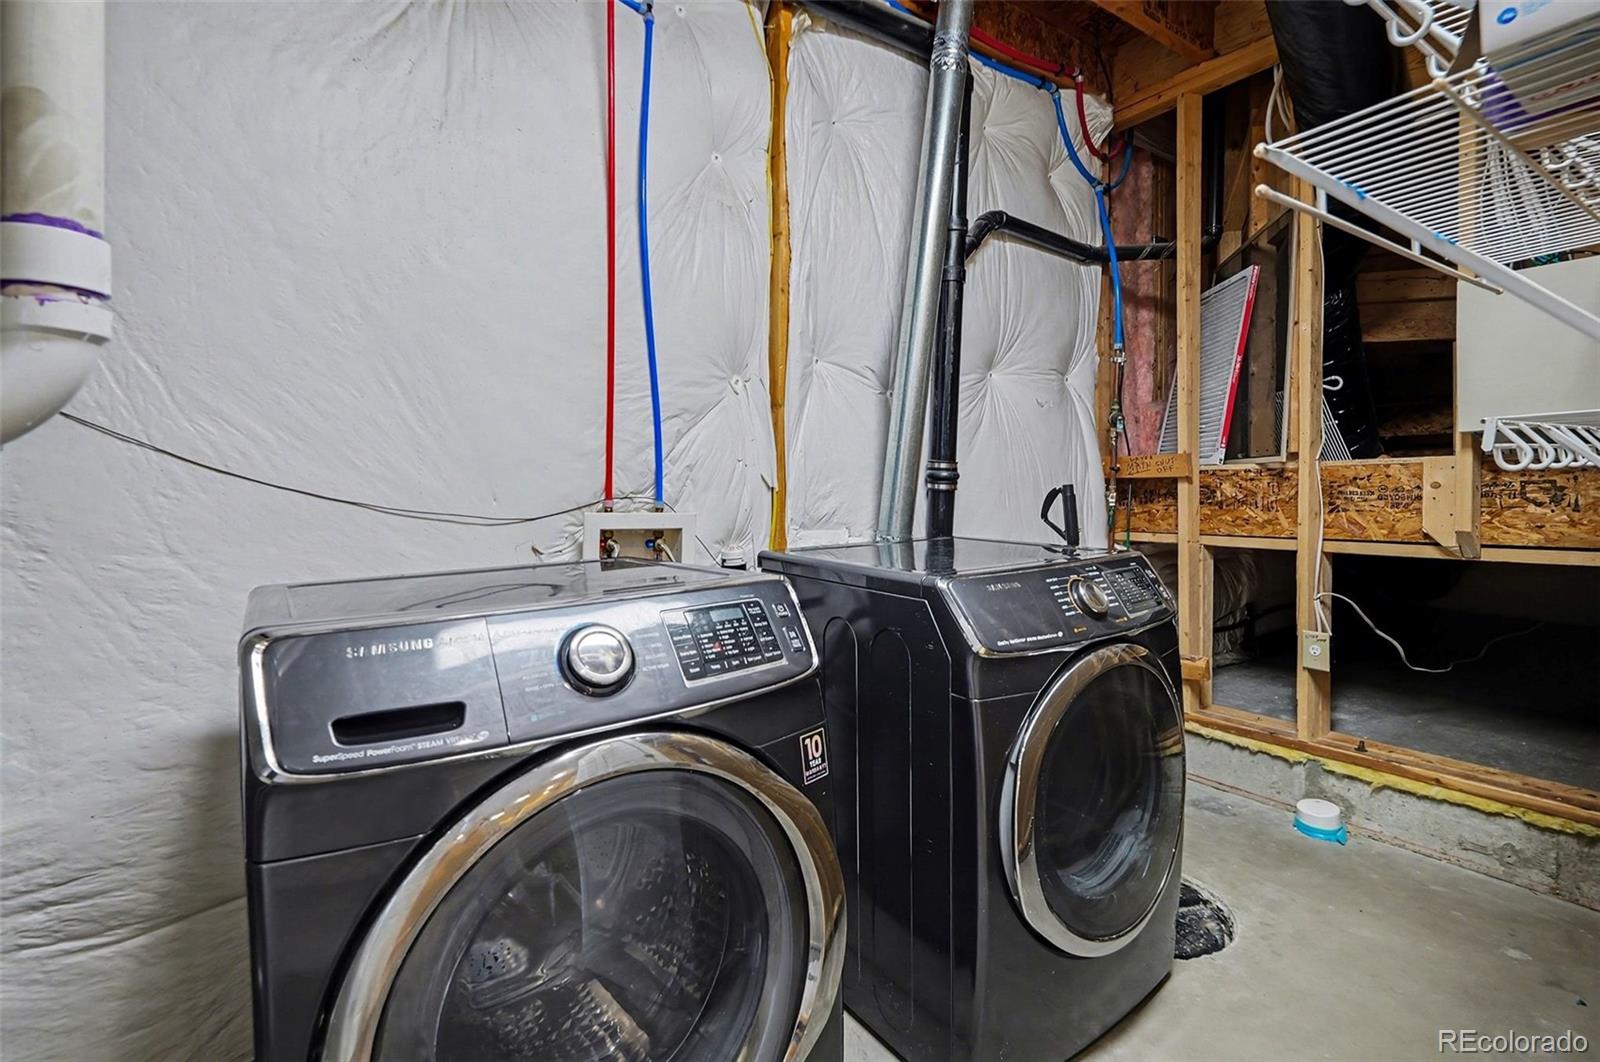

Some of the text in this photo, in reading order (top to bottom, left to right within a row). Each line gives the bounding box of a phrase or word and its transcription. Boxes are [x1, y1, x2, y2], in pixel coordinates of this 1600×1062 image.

[345, 638, 434, 659] SAMSUNG
[312, 750, 365, 764] SuperSpeed
[417, 740, 444, 750] STEAM
[804, 734, 822, 760] 10
